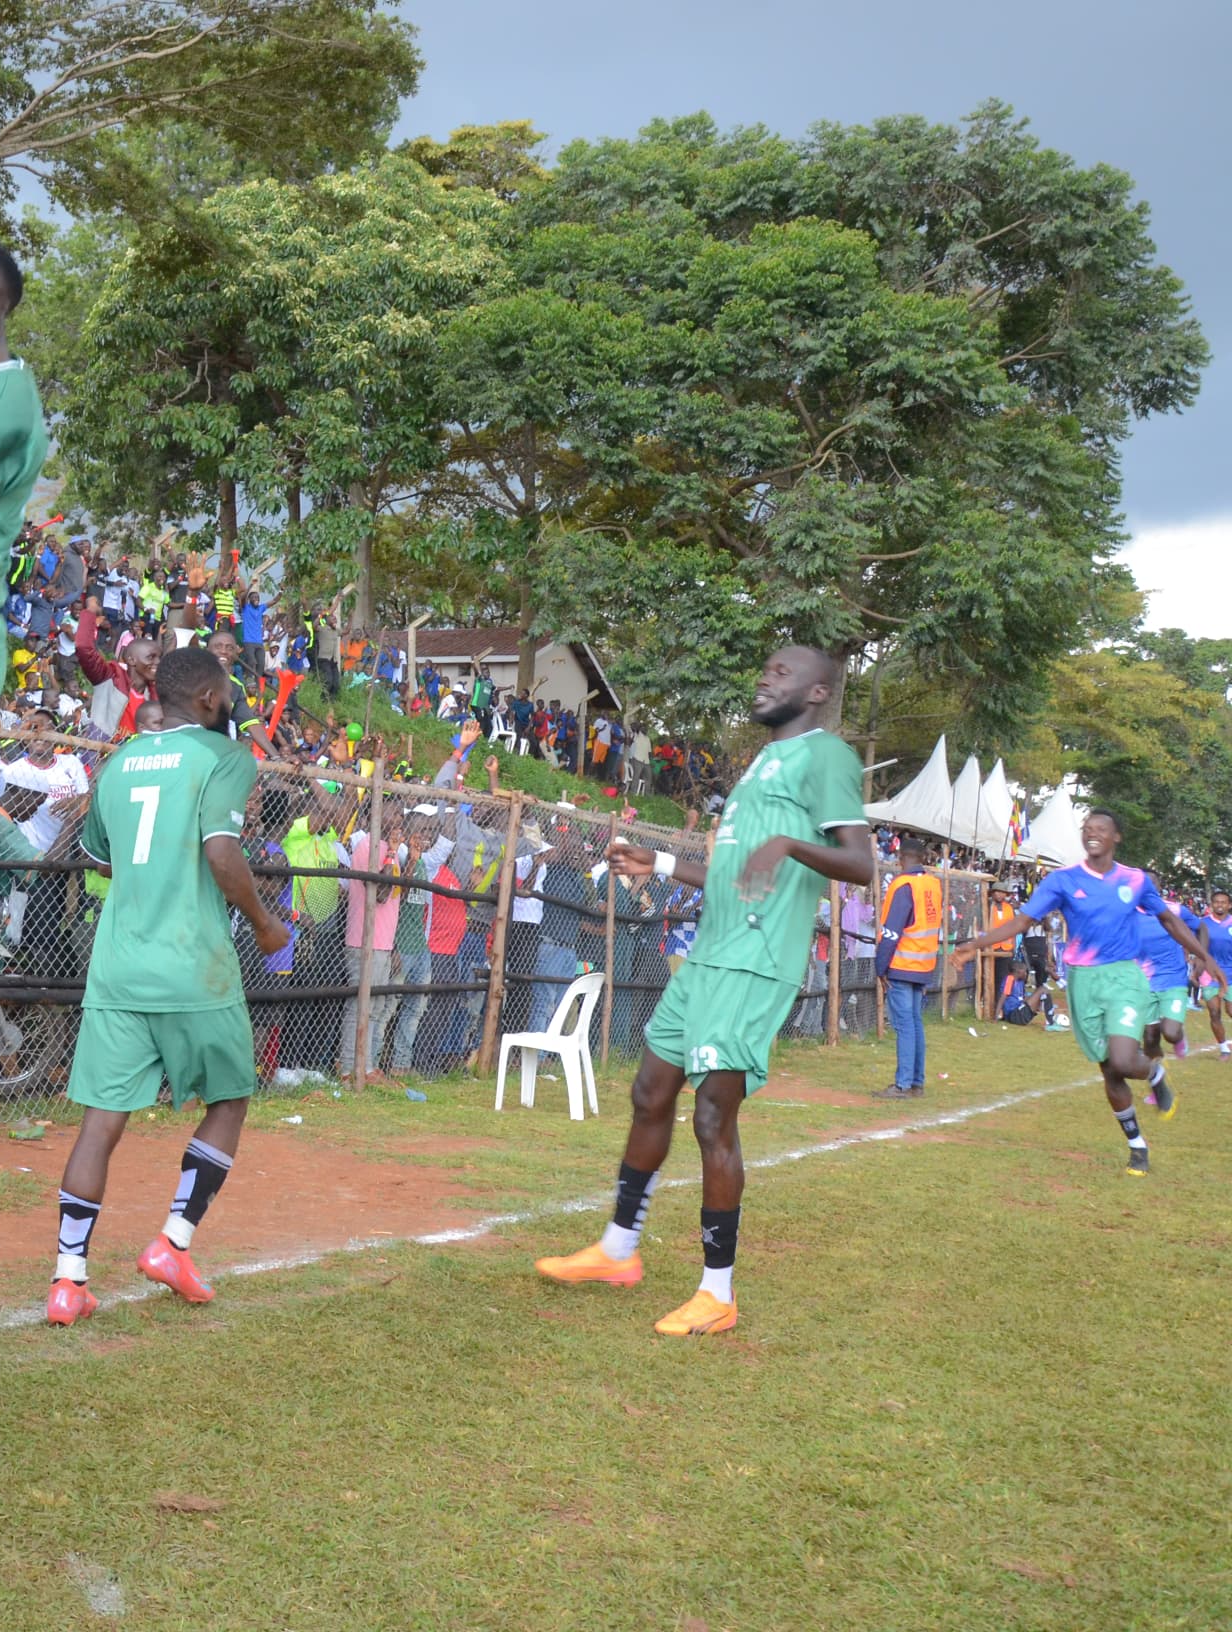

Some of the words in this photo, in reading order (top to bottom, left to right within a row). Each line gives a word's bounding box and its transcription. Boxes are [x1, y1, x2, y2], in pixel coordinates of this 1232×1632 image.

[122, 752, 183, 773] KYAGGWE
[130, 785, 161, 865] 7
[1119, 1005, 1138, 1027] 2
[1171, 999, 1183, 1014] 8
[689, 1045, 718, 1073] 13
